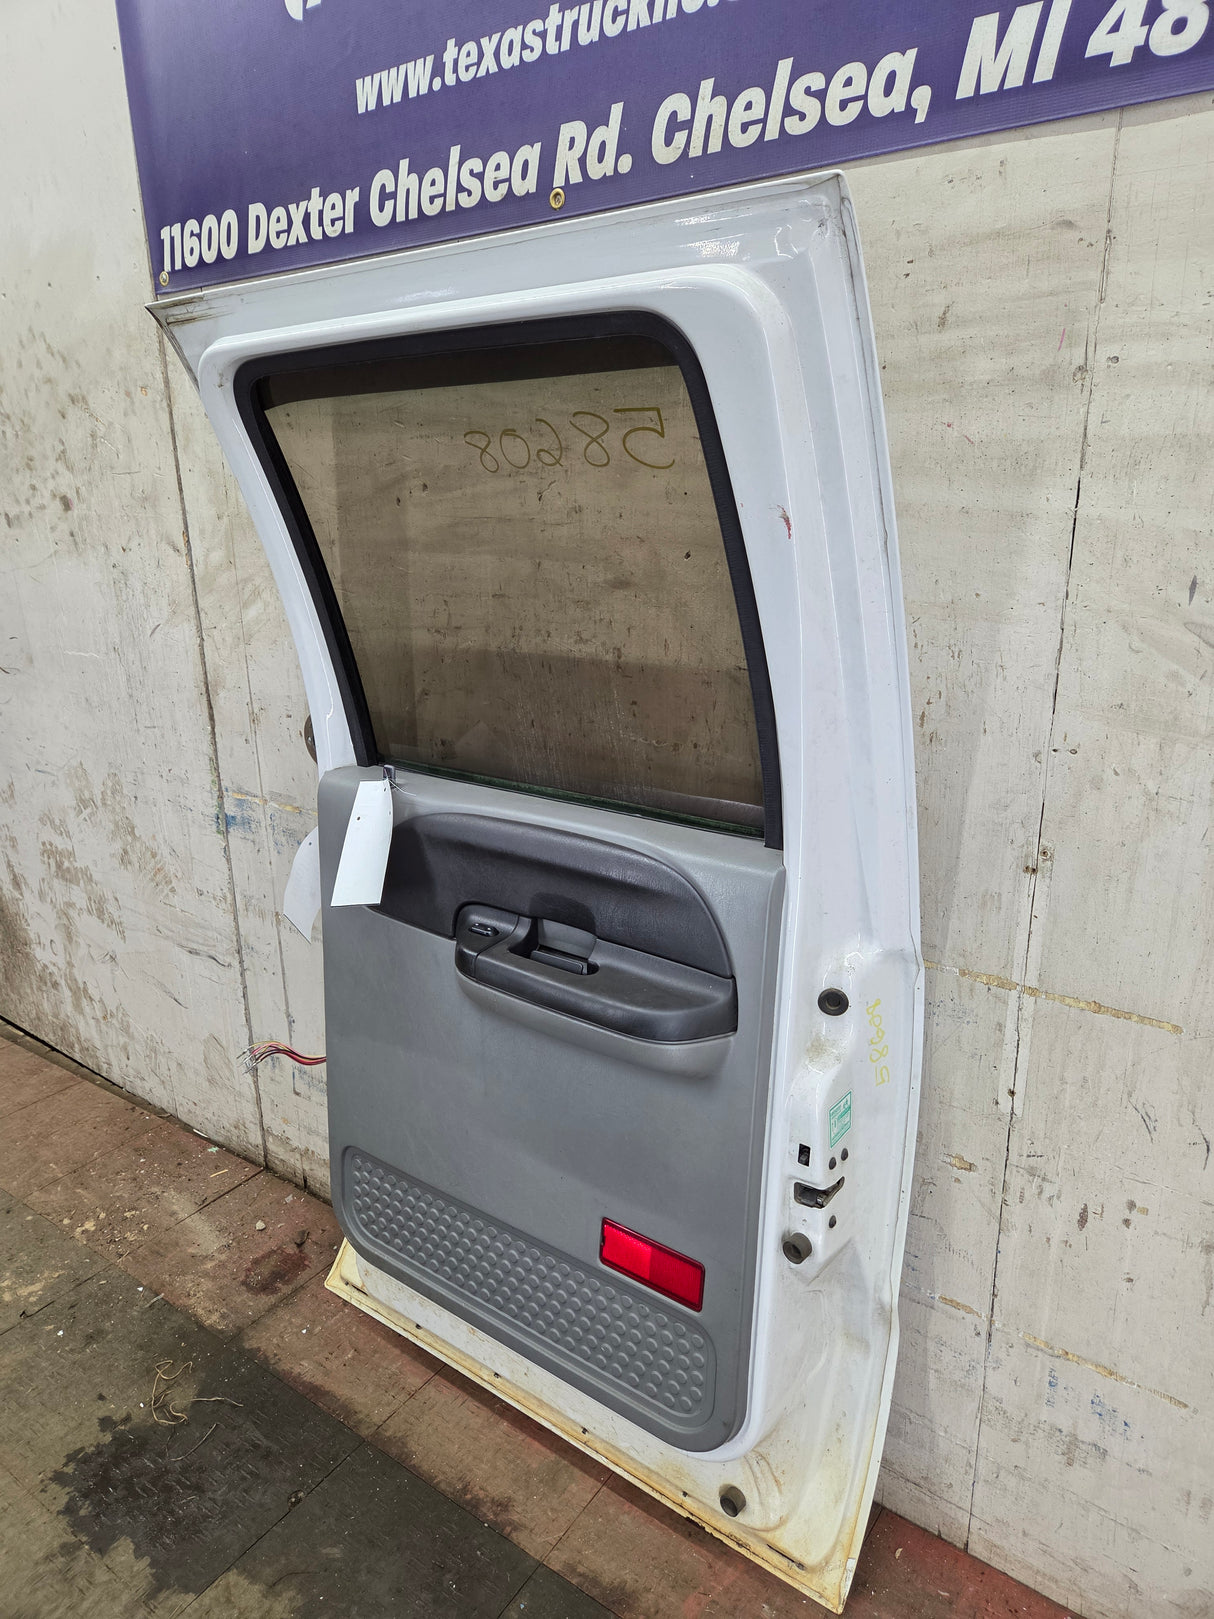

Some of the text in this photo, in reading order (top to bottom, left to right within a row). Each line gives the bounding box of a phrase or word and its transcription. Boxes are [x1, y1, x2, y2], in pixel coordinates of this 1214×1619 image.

[160, 208, 239, 272] 11600
[247, 187, 360, 255] Dexter
[369, 141, 541, 227] Chelsea
[552, 101, 633, 188] Rd.
[651, 48, 933, 166] Chelsea,
[955, 0, 1072, 100] MI
